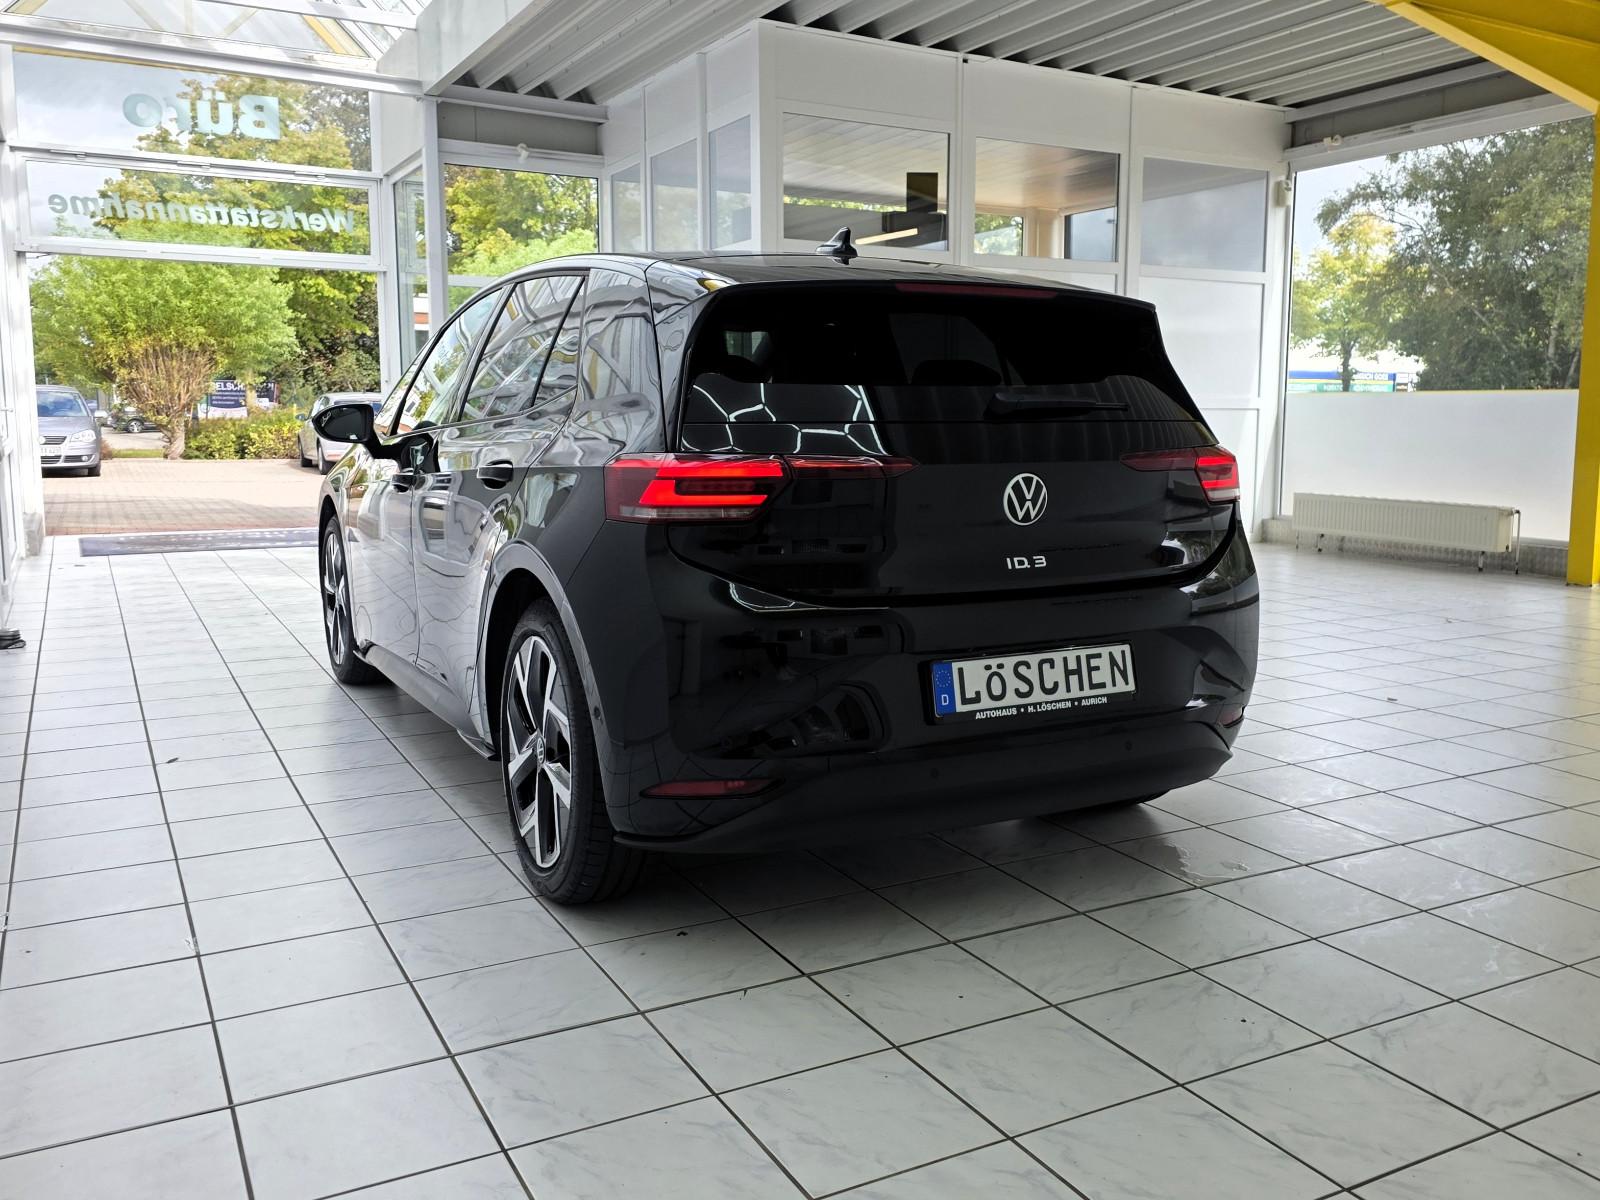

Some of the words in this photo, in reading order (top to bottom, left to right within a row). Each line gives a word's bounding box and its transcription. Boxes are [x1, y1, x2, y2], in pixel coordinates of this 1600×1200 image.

[941, 694, 949, 706] D
[957, 650, 1129, 705] LÖSCHEN
[975, 707, 1017, 720] AUTOHAUS
[1036, 700, 1071, 712] LÖSCHEN
[1081, 696, 1107, 706] AURICH
